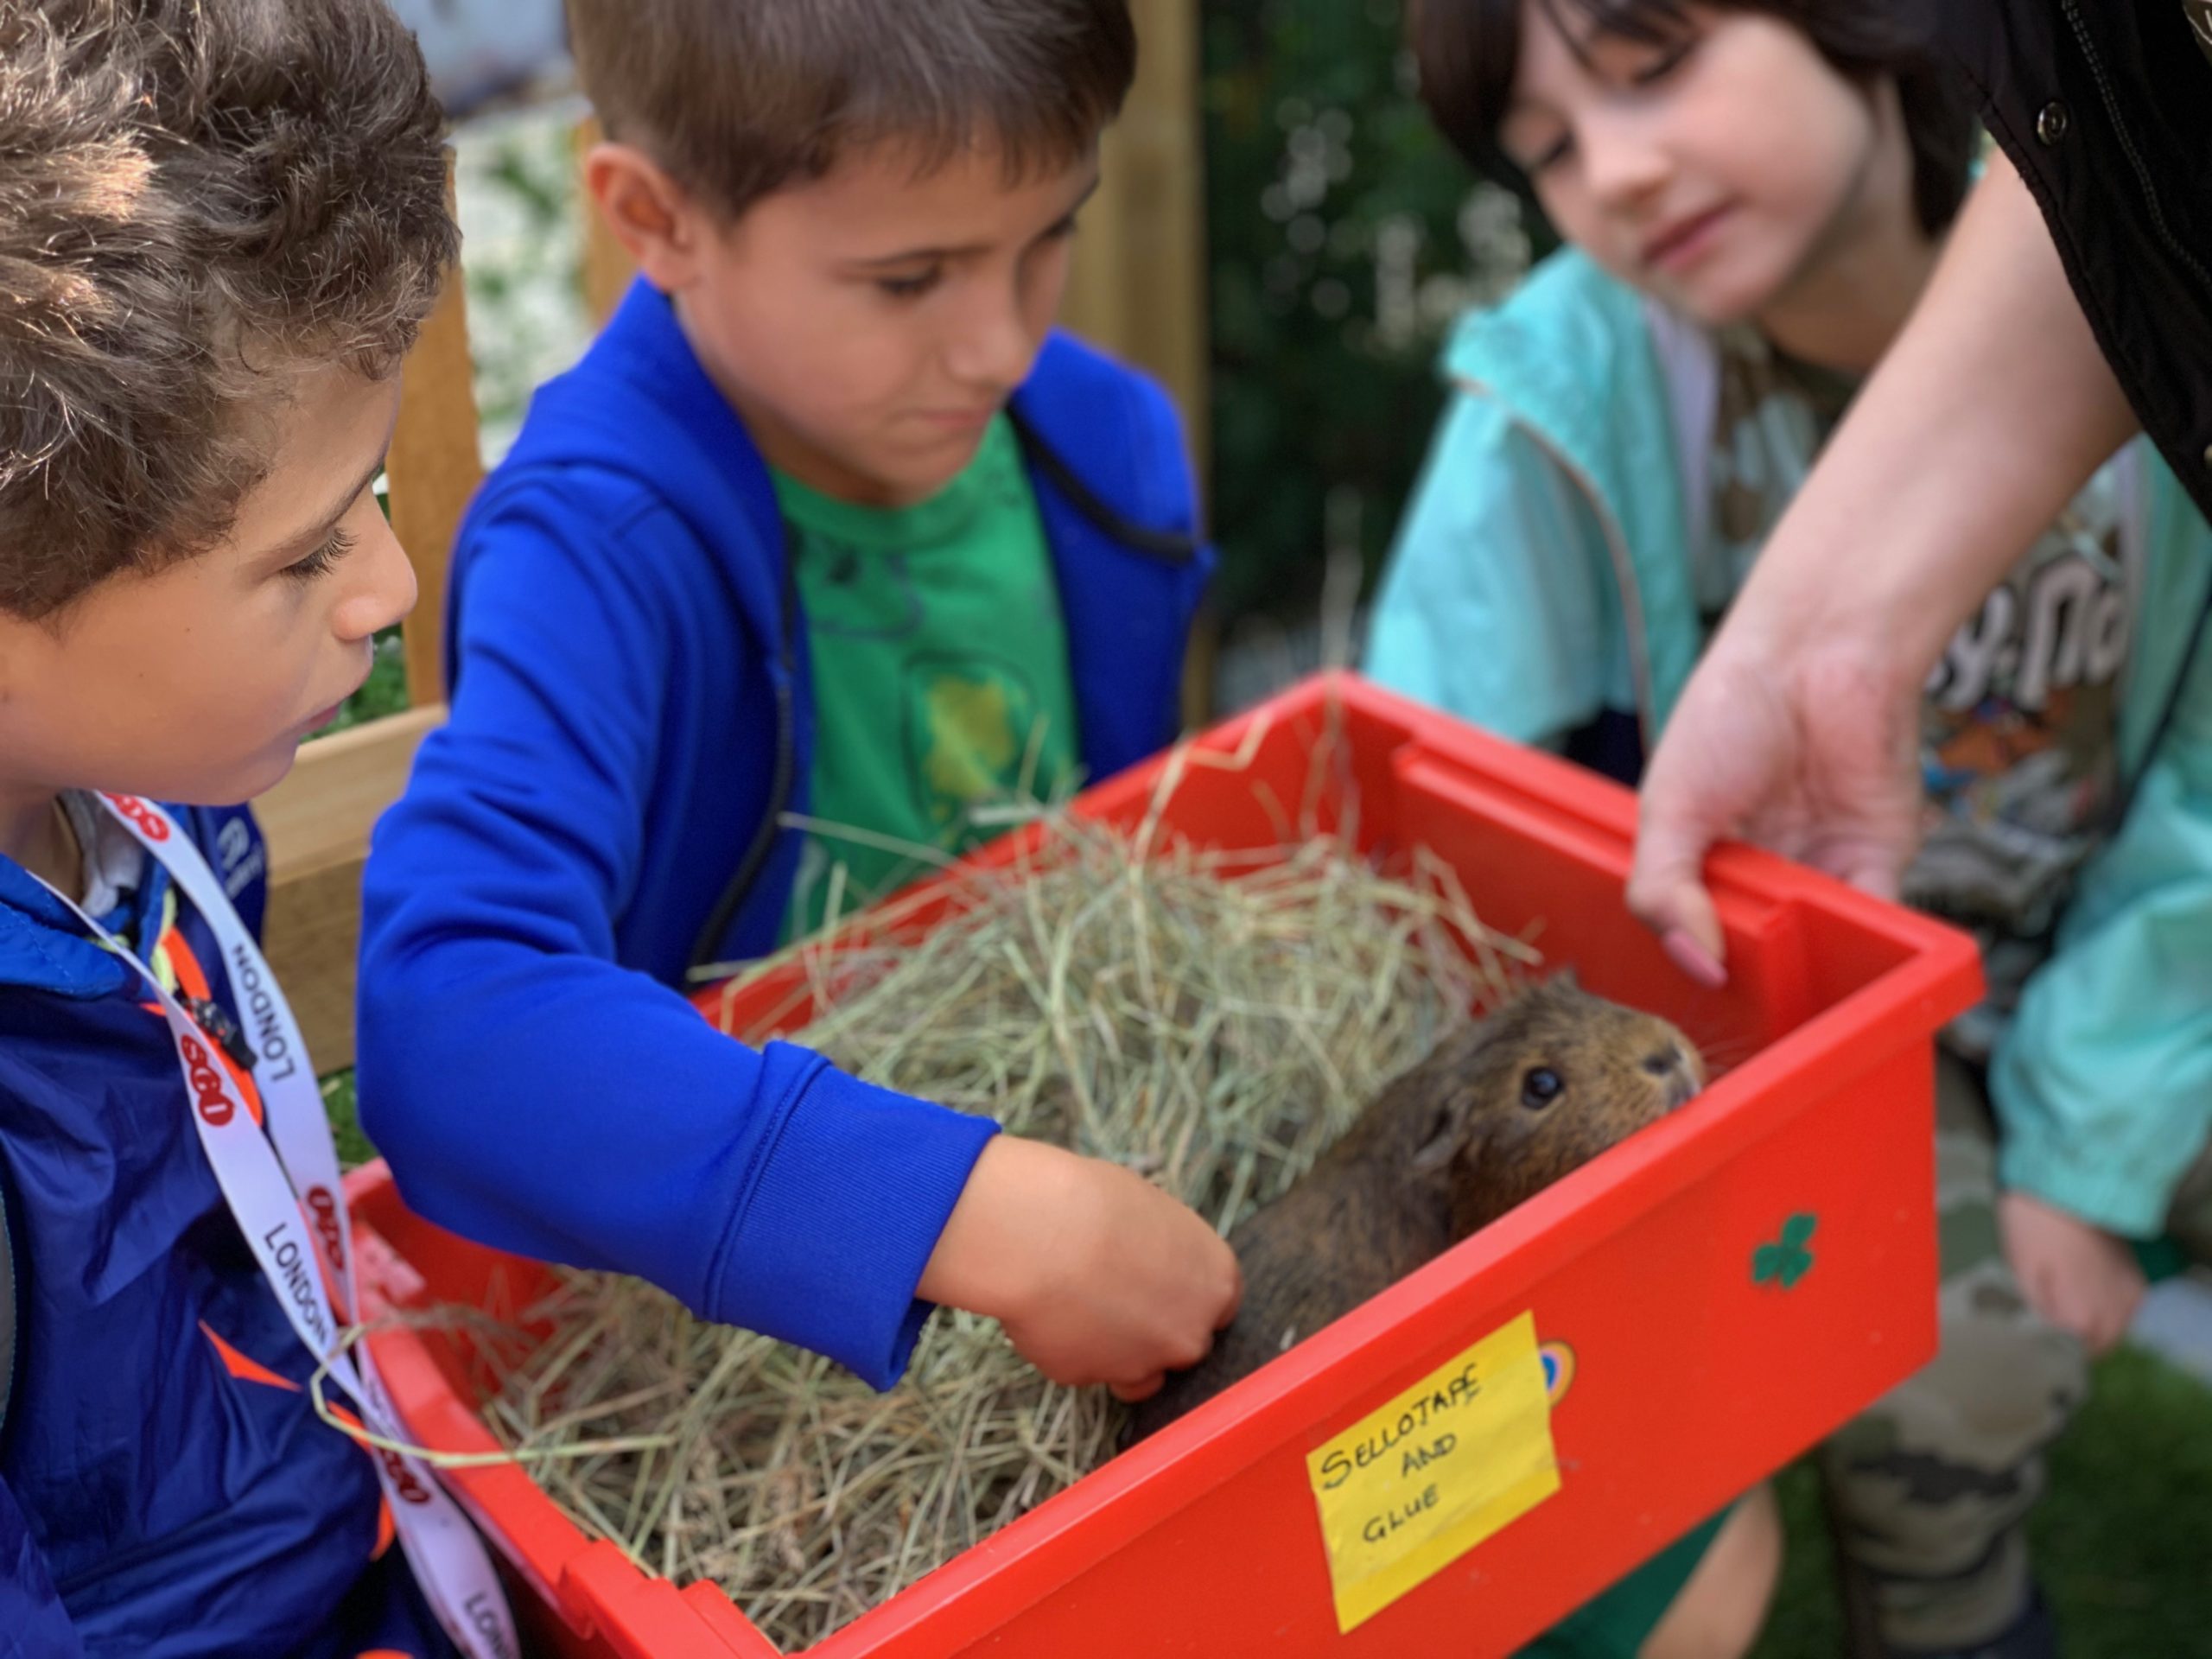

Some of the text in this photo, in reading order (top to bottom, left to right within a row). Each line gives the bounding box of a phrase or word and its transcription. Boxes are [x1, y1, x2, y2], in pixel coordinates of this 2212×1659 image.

[235, 944, 296, 1082] LONDON
[264, 1222, 327, 1343] LONDON
[1320, 1363, 1483, 1491] SELLOTAPE
[1402, 1433, 1457, 1477] AND
[1363, 1484, 1440, 1543] GLUE
